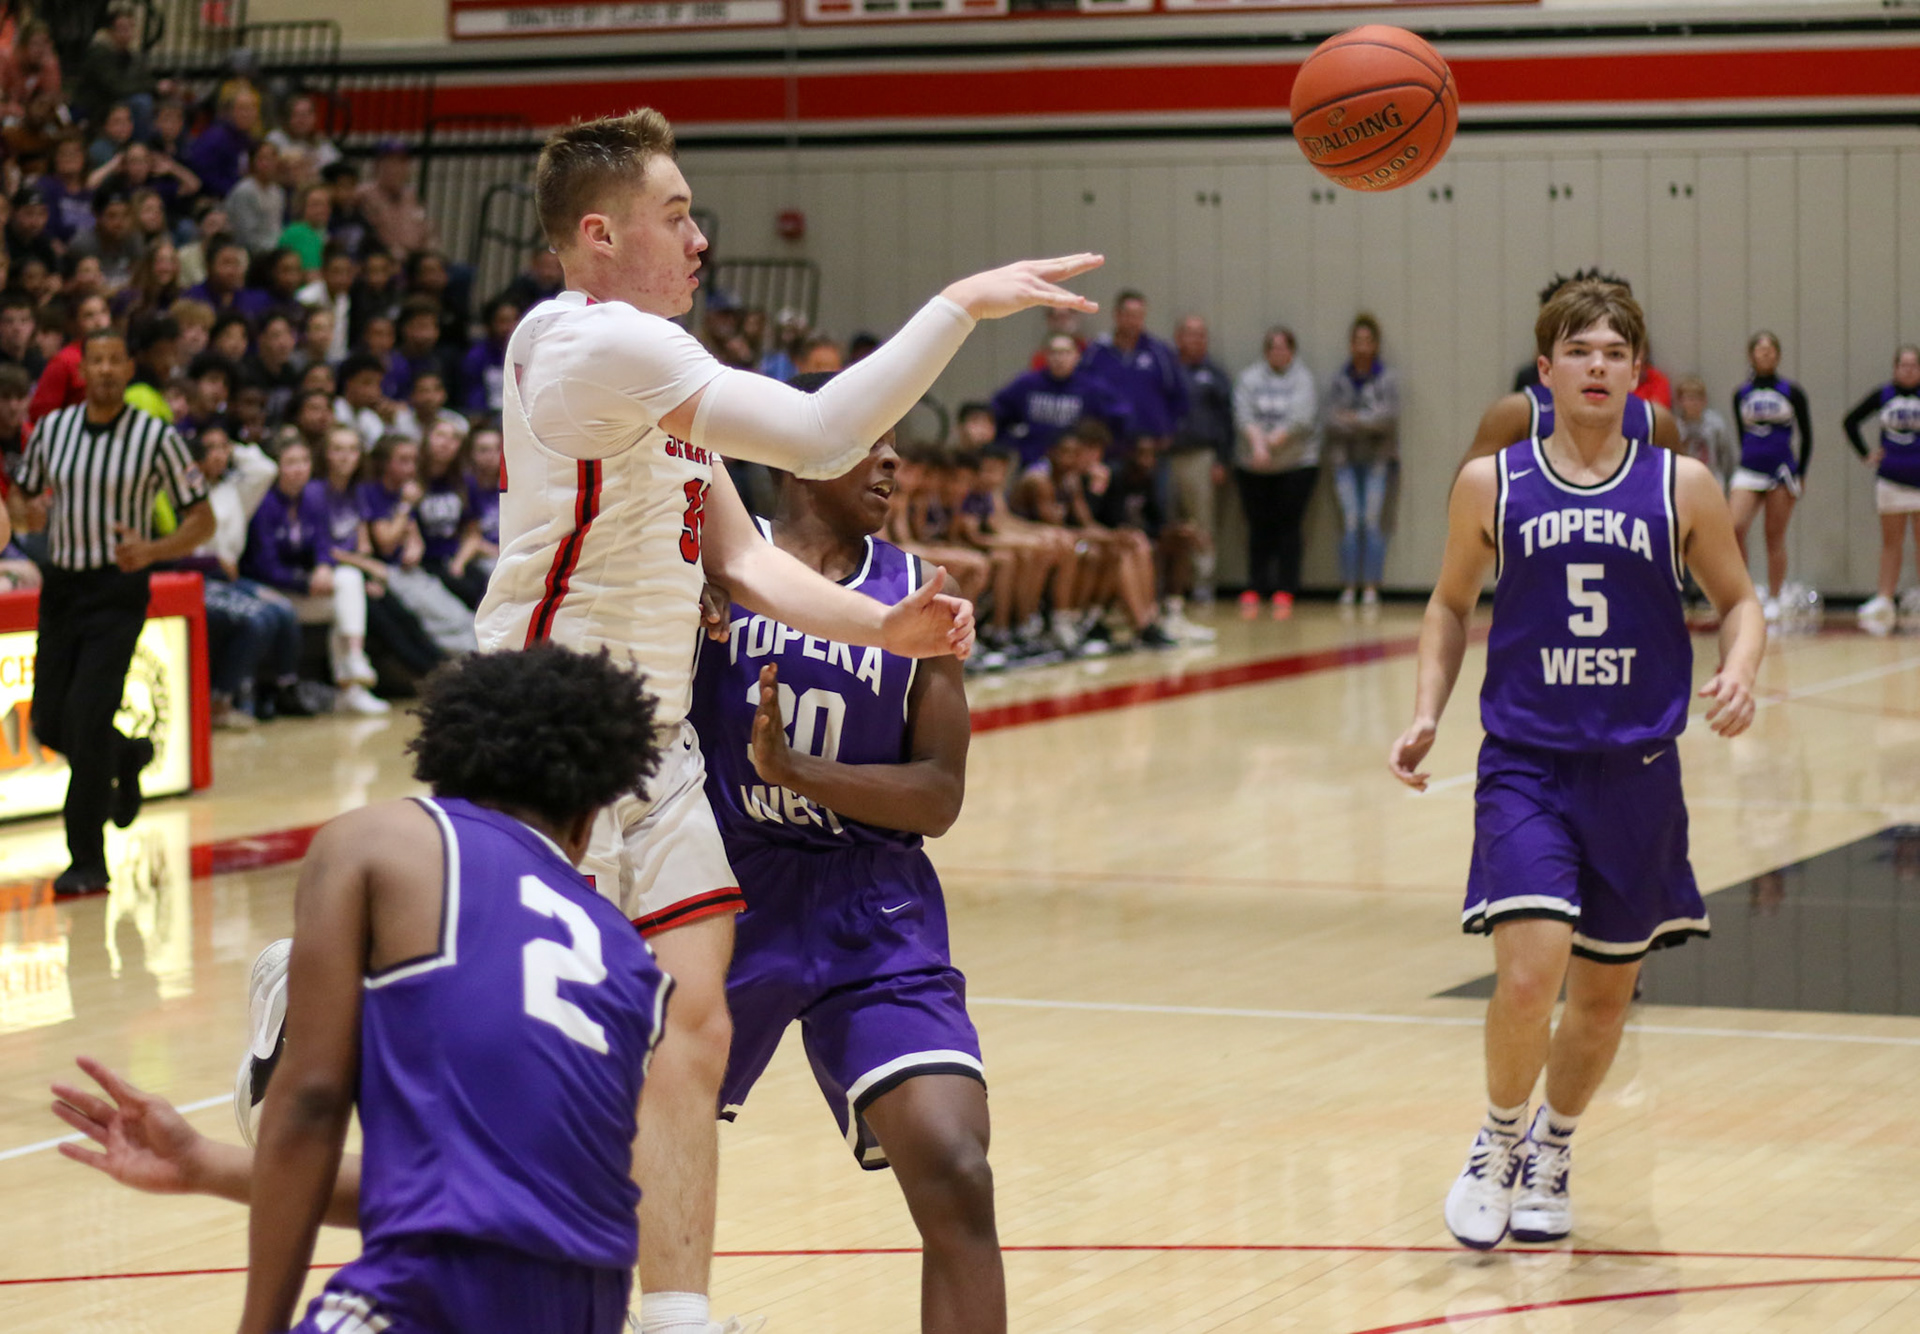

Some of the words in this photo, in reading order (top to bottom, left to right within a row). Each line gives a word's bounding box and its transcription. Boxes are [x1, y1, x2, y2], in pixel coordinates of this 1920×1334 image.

[1303, 102, 1405, 159] SPALDING
[1519, 508, 1653, 562] TOPEKA
[1566, 563, 1609, 638] 5
[1540, 647, 1637, 686] WEST
[519, 874, 610, 1056] 2
